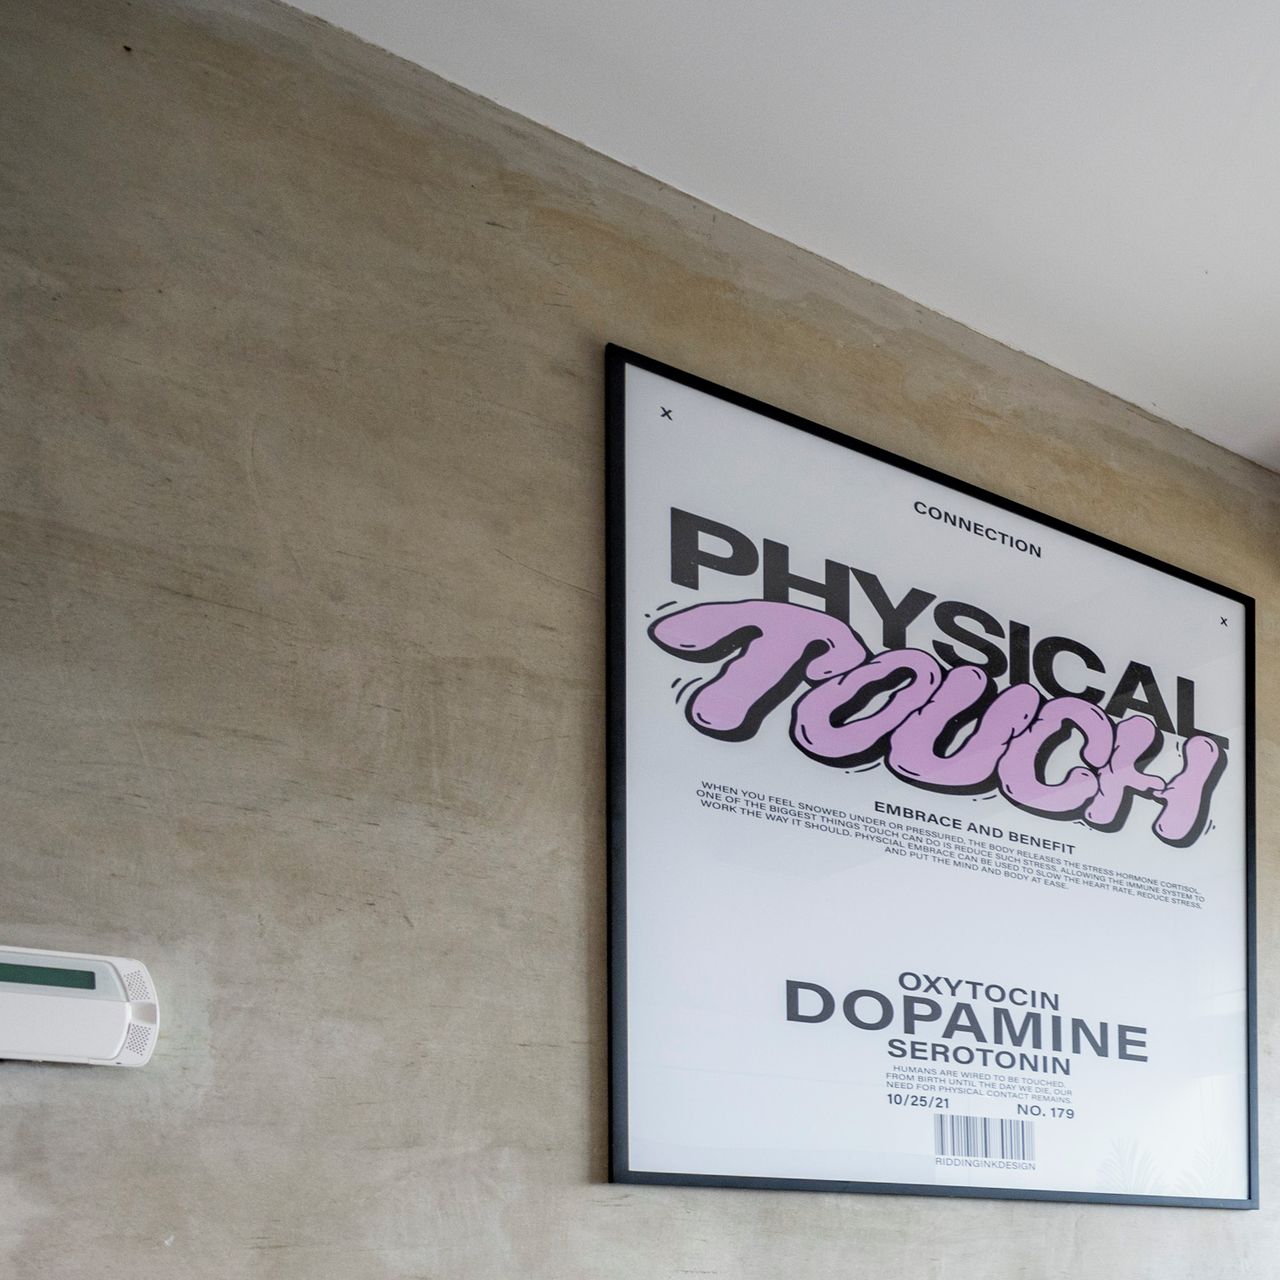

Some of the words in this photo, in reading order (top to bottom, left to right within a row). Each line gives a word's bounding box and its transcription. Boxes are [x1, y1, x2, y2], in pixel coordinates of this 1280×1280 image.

[913, 500, 1043, 558] CONNECTION
[670, 506, 1229, 750] PHYSICAL
[647, 598, 1228, 849] TOUCH
[696, 789, 722, 801] ONE
[725, 796, 741, 804] OF
[743, 799, 767, 811] THE
[769, 805, 817, 821] BIGGEST
[820, 815, 860, 830] THINGS
[864, 825, 899, 839] TOUCH
[902, 833, 923, 843] CAN
[926, 838, 940, 847] DO
[954, 844, 993, 858] REDUCE
[995, 852, 1021, 864] SUCH
[1061, 867, 1106, 882] ALLOWING
[1108, 877, 1124, 886] THE
[1126, 881, 1161, 894] IMMUNE
[1162, 888, 1192, 901] SYSTEM
[1195, 895, 1205, 903] TO
[701, 781, 738, 795] WHEN
[741, 790, 765, 801] YOU
[768, 796, 795, 807] FEEL
[798, 802, 846, 819] SNOWED
[850, 813, 886, 827] UNDER
[889, 822, 903, 831] OR
[969, 839, 986, 849] THE
[989, 843, 1015, 855] BODY
[1017, 849, 1061, 865] RELEASES
[1064, 860, 1080, 869] THE
[1082, 864, 1114, 876] STRESS
[1116, 872, 1158, 886] HORMONE
[875, 801, 962, 830] EMBRACE
[967, 822, 1003, 839] AND
[1009, 831, 1076, 855] BENEFIT
[700, 799, 737, 813] WORK
[740, 807, 763, 818] THE
[765, 812, 789, 824] WAY
[792, 818, 802, 827] IT
[804, 821, 852, 838] SHOULD.
[855, 831, 905, 848] PHYSCIAL
[907, 843, 955, 859] EMBRACE
[958, 852, 979, 863] CAN
[981, 857, 993, 866] BE
[995, 861, 1020, 872] USED
[1022, 866, 1034, 875] TO
[1036, 869, 1063, 881] SLOW
[1064, 874, 1081, 884] THE
[1083, 879, 1111, 891] HEART
[1137, 890, 1171, 903] REDUCE
[885, 847, 907, 857] AND
[909, 851, 929, 861] PUT
[932, 856, 951, 865] THE
[953, 860, 979, 871] MIND
[981, 867, 1001, 876] AND
[1004, 871, 1029, 882] BODY
[1031, 876, 1042, 885] AT
[899, 971, 1060, 1011] OXYTOCIN
[785, 978, 1149, 1063] DOPAMINE
[887, 1038, 1071, 1076] SEROTONIN
[893, 1065, 937, 1076] HUMANS
[940, 1069, 958, 1078] ARE
[960, 1072, 991, 1081] WIRED
[1008, 1076, 1020, 1084] BE
[886, 1072, 915, 1082] FROM
[917, 1075, 946, 1084] BIRTH
[948, 1078, 977, 1087] UNTIL
[980, 1081, 997, 1089] THE
[999, 1082, 1016, 1091] DAY
[1018, 1084, 1033, 1093] WE
[1054, 1088, 1072, 1096] OUR
[886, 1081, 914, 1090] NEED
[916, 1084, 937, 1092] FOR
[939, 1086, 983, 1097] PHYSICAL
[987, 1089, 1029, 1100] CONTACT
[887, 1093, 949, 1108] 10/25/21
[1017, 1104, 1046, 1117] NO.
[1051, 1107, 1075, 1119] 179
[935, 1157, 1036, 1171] RIDDINGINKDESIGN
